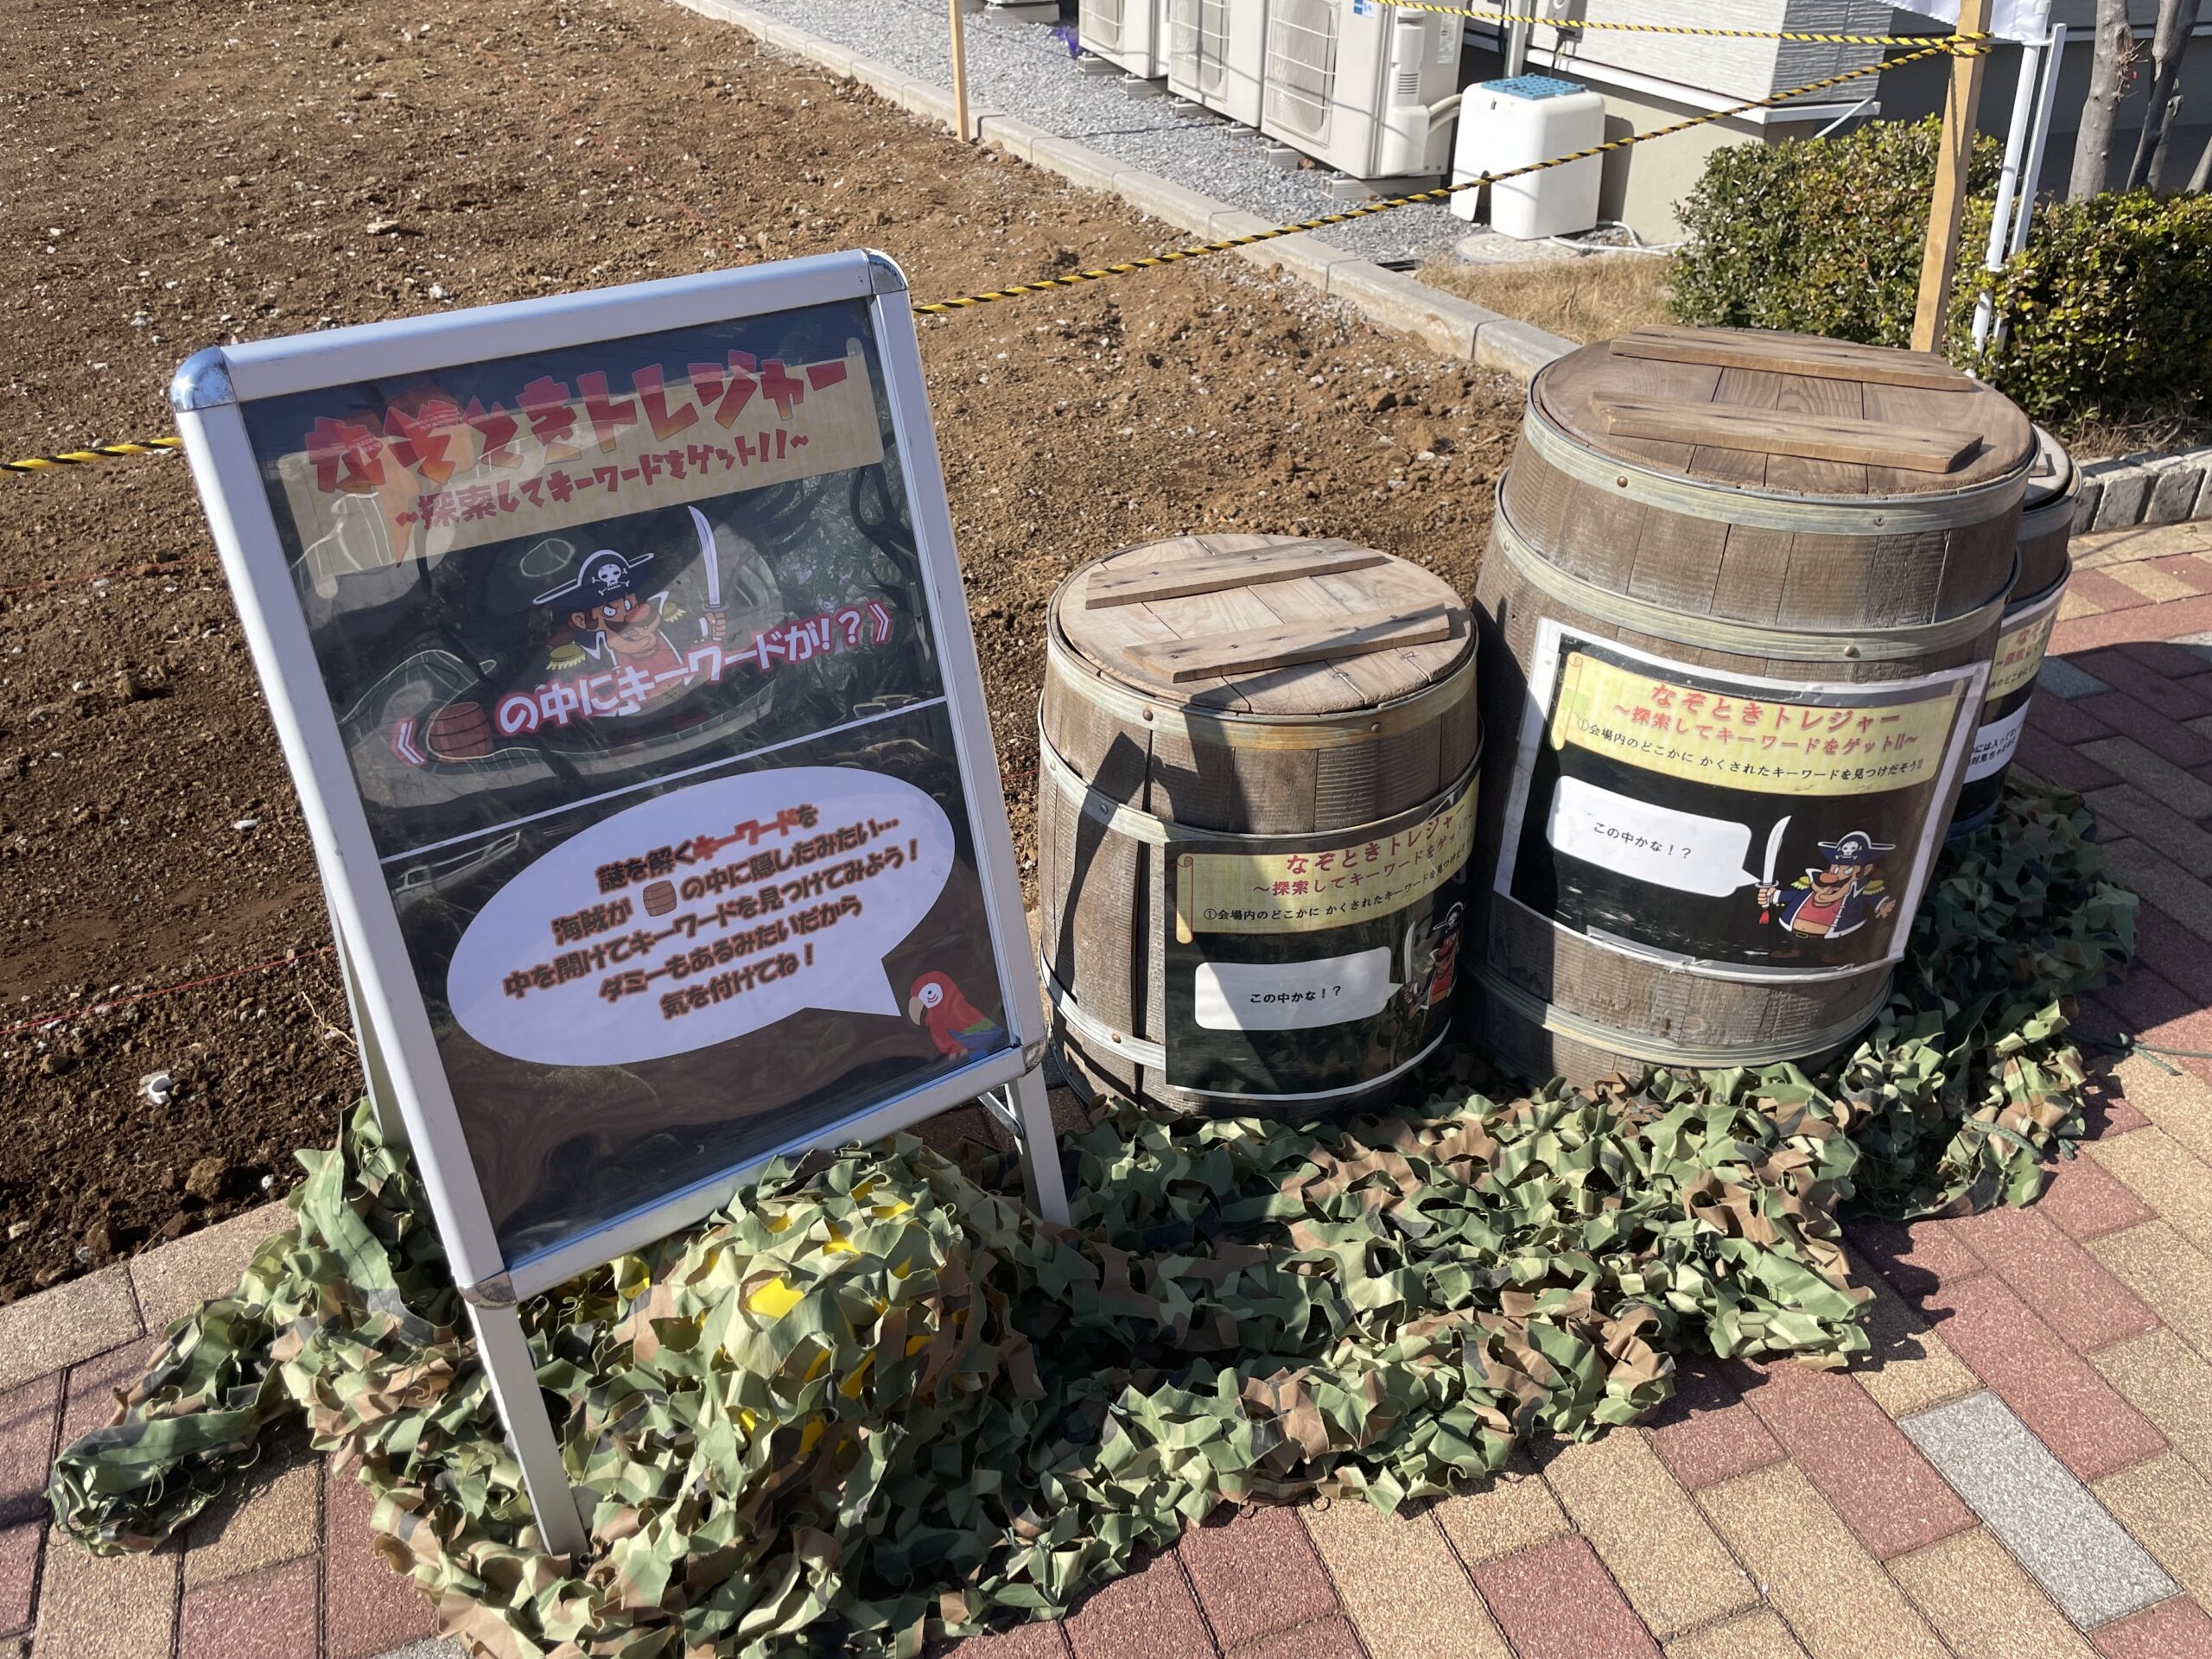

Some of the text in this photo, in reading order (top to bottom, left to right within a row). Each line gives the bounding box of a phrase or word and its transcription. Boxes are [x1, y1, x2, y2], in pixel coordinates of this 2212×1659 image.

[1652, 683, 1900, 731] なぞときトレジャー
[595, 803, 819, 894] 謎を解くキーワードを
[1287, 804, 1465, 874] なぞときトレジャー
[550, 896, 632, 946] 海賊が
[600, 894, 861, 1004] ダミーもあるみたいだから
[660, 944, 816, 1021] 気を付けてね！
